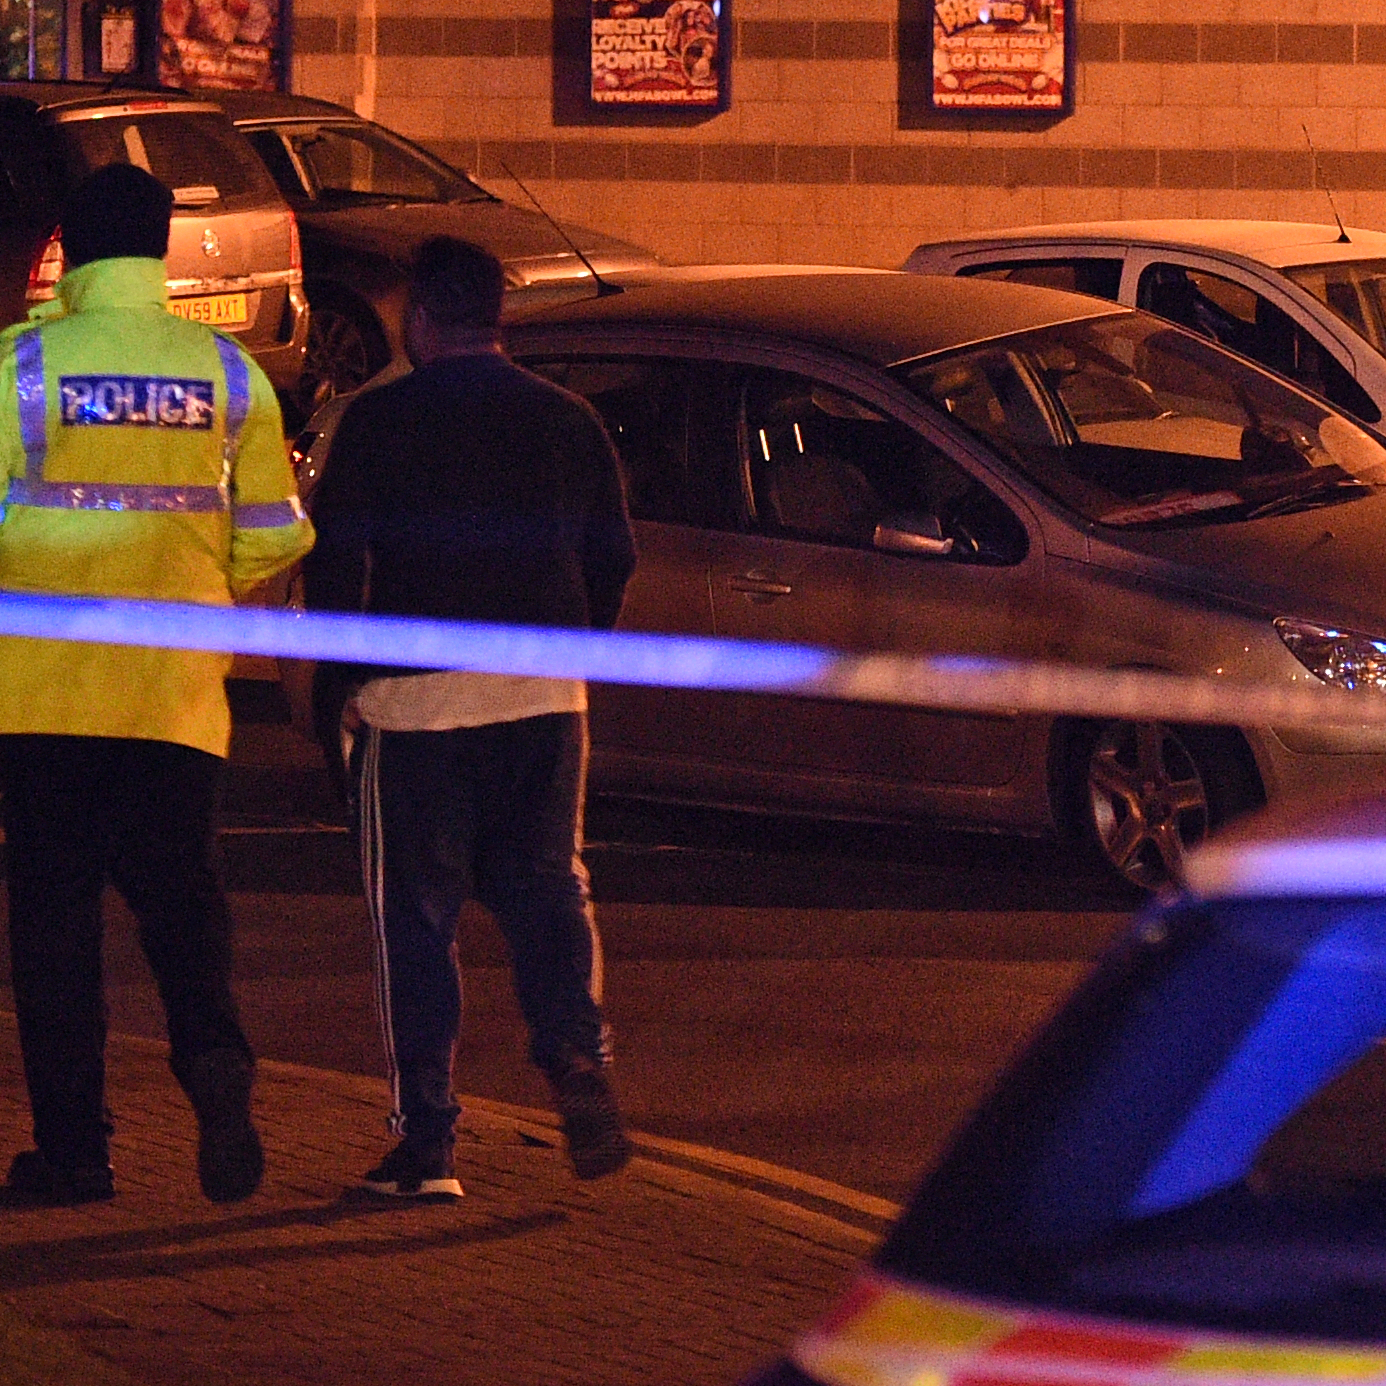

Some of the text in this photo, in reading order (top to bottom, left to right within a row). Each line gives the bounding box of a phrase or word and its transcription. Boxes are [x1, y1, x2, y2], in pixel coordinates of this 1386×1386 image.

[591, 35, 667, 51] LOYALTY
[591, 51, 667, 70] POINTS
[216, 299, 238, 320] AXT
[63, 380, 211, 426] POLICE
